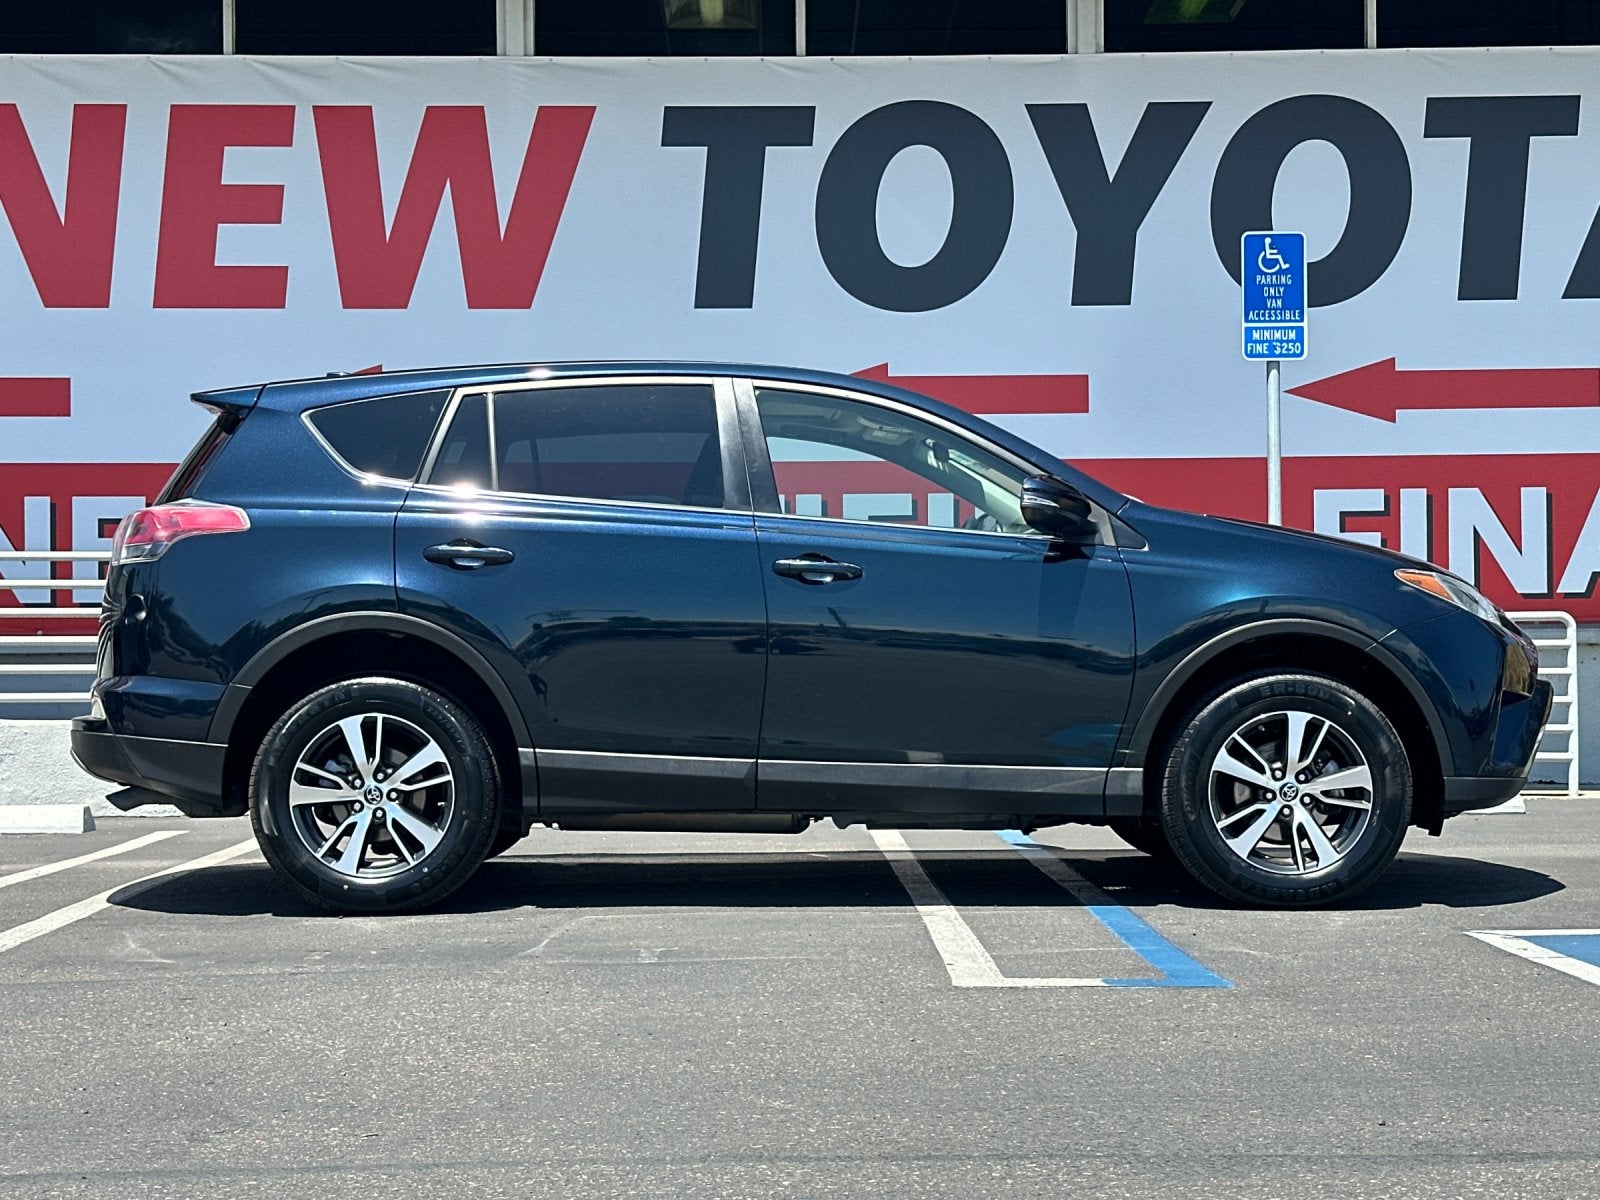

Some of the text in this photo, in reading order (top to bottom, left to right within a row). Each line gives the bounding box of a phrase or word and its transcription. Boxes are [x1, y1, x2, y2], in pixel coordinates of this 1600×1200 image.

[0, 95, 1600, 312] NEW TOYOT
[1256, 274, 1292, 285] PARKING
[1263, 286, 1285, 297] ONLY
[1266, 298, 1282, 308] VAN
[1248, 310, 1301, 320] ACCESSIBLE
[1252, 329, 1296, 340] MINIMUM
[1247, 343, 1269, 354] FINE
